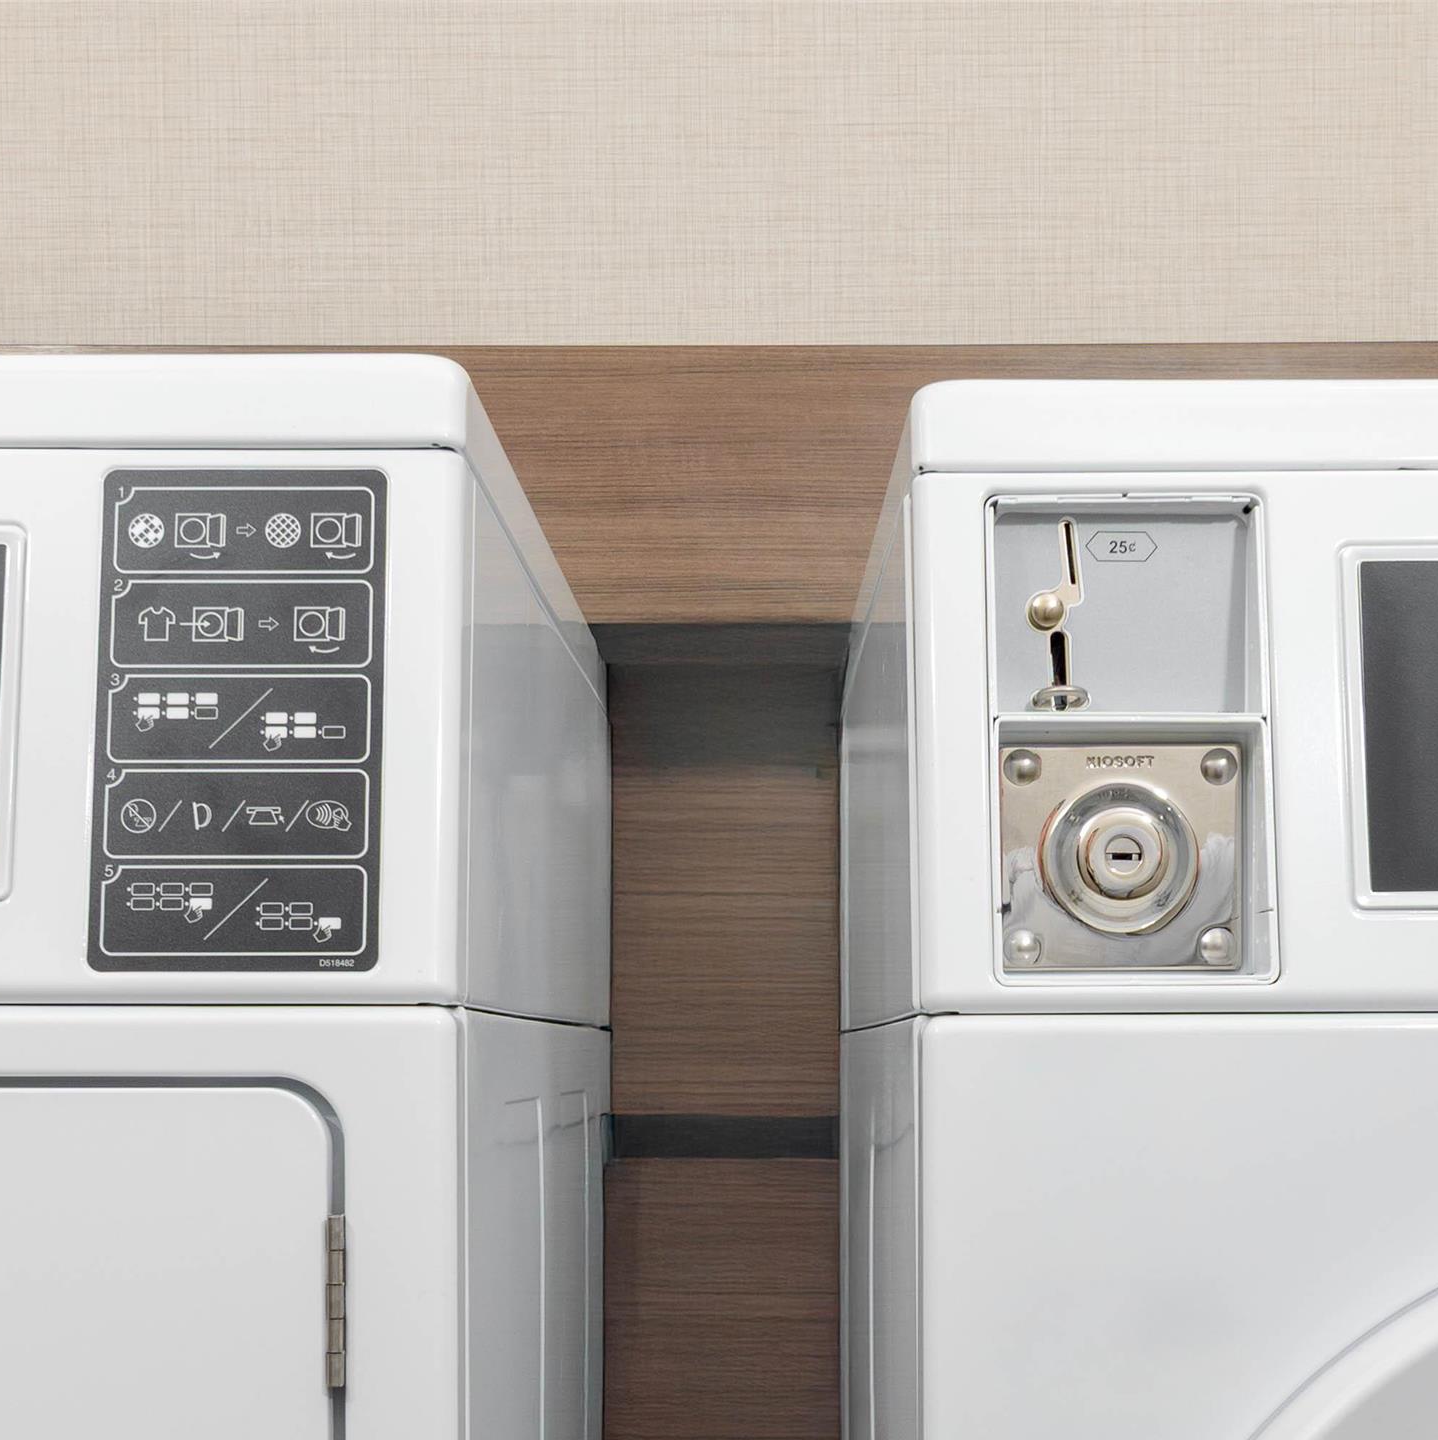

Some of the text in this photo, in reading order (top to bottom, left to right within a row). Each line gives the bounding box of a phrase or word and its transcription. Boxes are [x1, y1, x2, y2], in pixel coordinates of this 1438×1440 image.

[117, 486, 125, 498] 1
[113, 580, 123, 592] 2
[110, 674, 120, 686] 3
[1086, 755, 1155, 768] KIOSOFT
[106, 769, 117, 781] 4
[104, 866, 114, 877] 5
